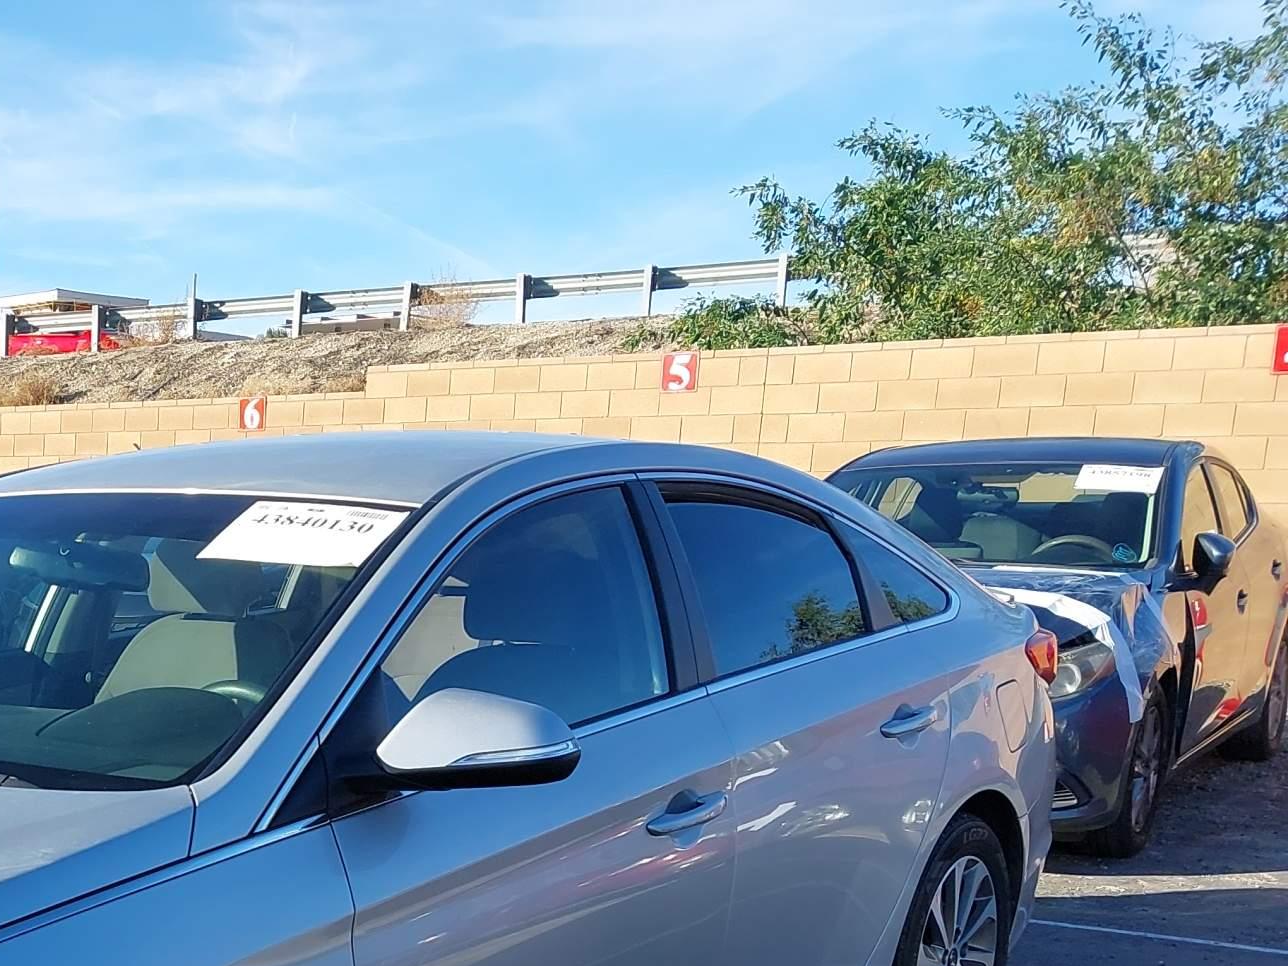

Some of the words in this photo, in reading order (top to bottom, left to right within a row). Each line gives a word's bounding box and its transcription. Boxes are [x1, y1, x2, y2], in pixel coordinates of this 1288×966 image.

[668, 353, 691, 391] 5
[243, 398, 261, 430] 6
[253, 513, 374, 534] 43840130
